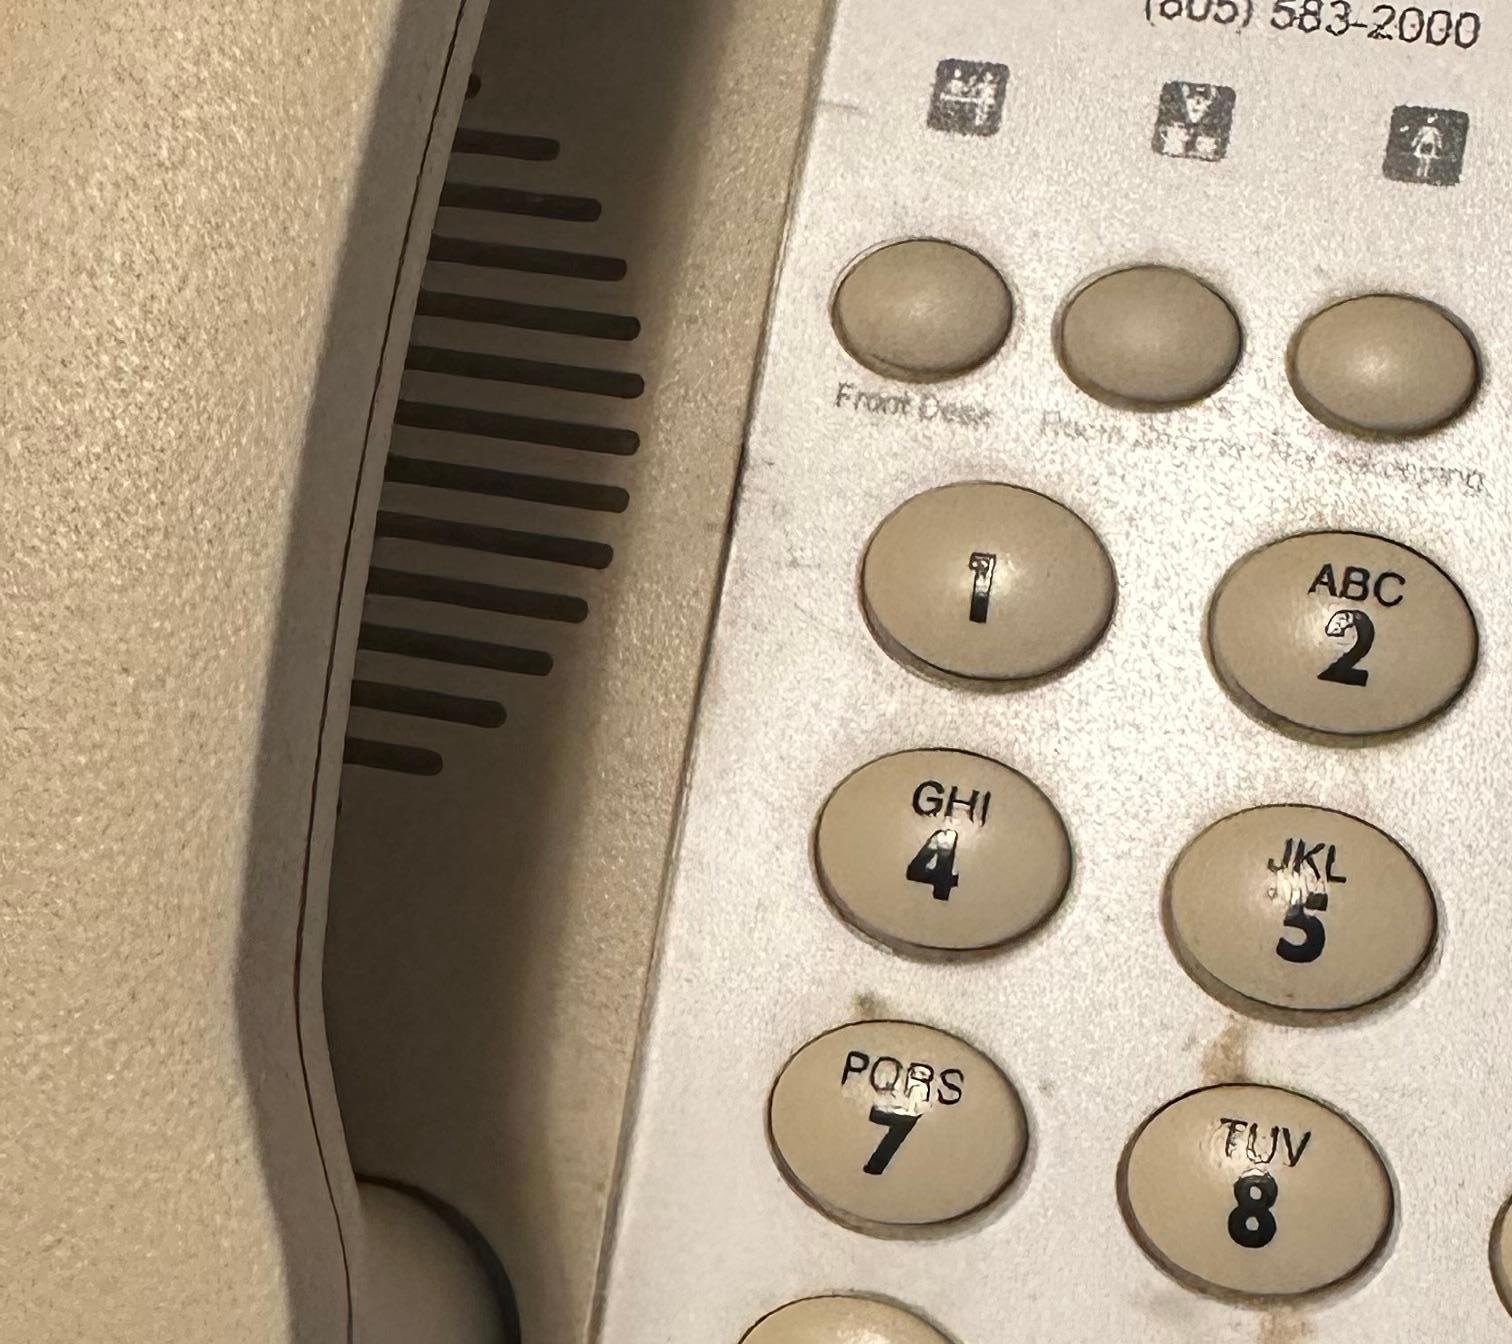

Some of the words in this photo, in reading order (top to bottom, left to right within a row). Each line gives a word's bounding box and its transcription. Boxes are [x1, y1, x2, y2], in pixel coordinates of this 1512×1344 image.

[968, 552, 996, 623] 1
[1308, 563, 1405, 607] ABC
[1317, 609, 1375, 687] 2
[912, 781, 990, 828] GHI
[906, 829, 959, 900] 4
[1267, 838, 1347, 884] JKL
[1276, 885, 1328, 963] 5
[841, 1052, 964, 1105] PQRS
[863, 1105, 921, 1175] 7
[1219, 1117, 1311, 1168] TUV
[1228, 1171, 1277, 1248] 8
